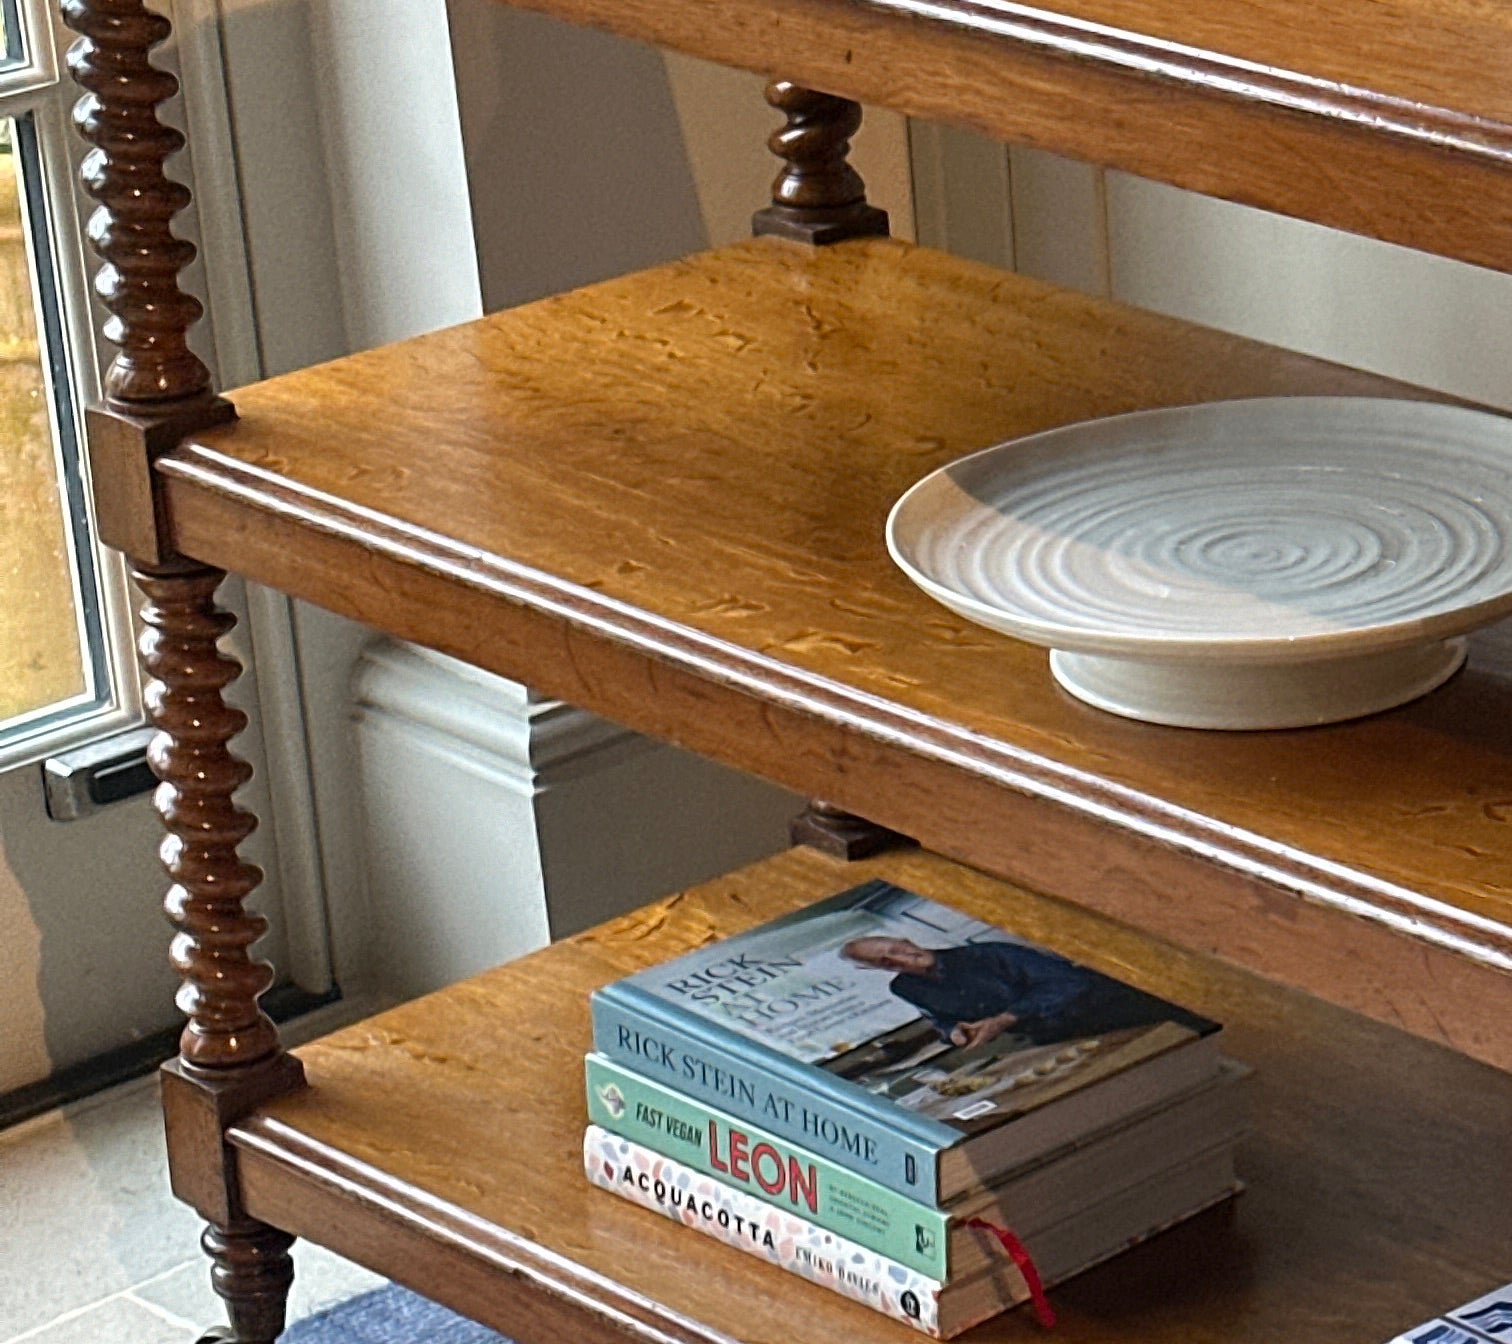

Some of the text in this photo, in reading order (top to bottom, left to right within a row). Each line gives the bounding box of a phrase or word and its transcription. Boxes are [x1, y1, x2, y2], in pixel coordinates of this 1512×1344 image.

[666, 953, 757, 995] RICK
[691, 955, 803, 1003] STEIN
[616, 1024, 878, 1166] RICK STEIN AT HOME
[635, 1103, 703, 1148] FAST VEGAN
[708, 1119, 819, 1215] LEON
[622, 1165, 776, 1250] ACQUACOTTA
